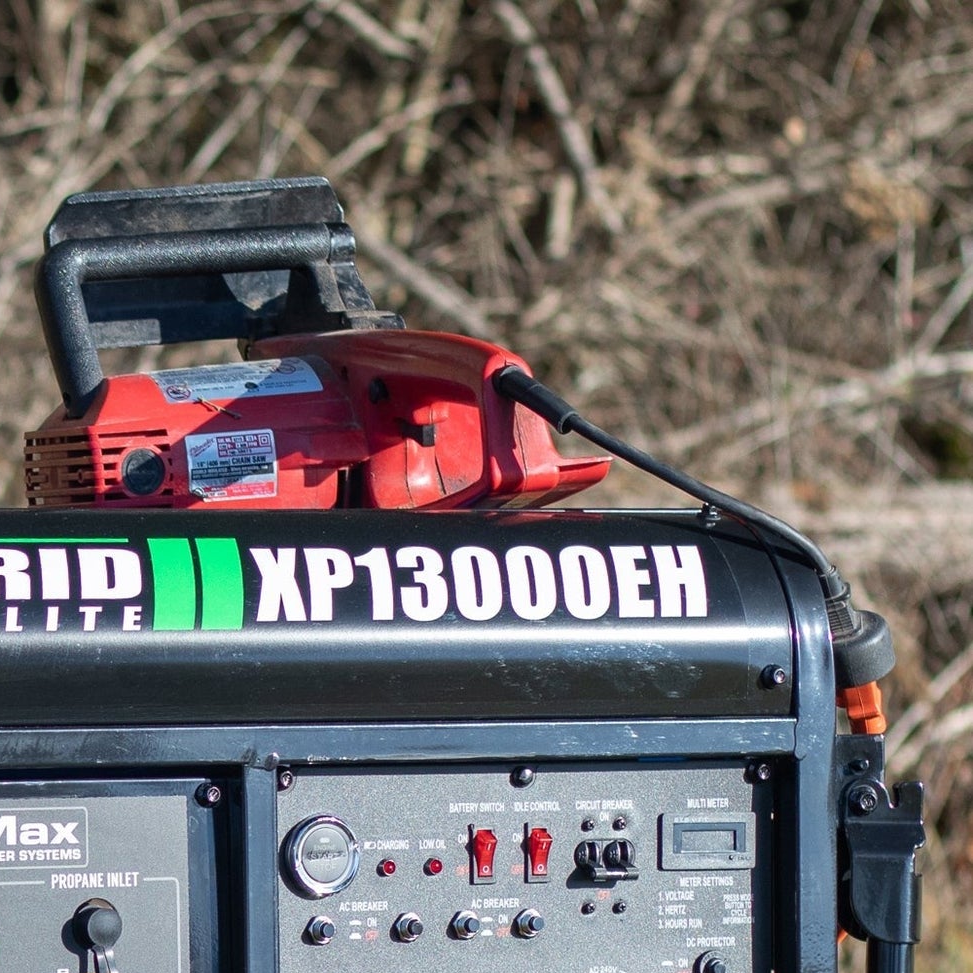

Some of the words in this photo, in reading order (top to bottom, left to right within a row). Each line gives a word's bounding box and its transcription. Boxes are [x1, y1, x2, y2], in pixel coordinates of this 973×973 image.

[231, 456, 251, 465] CHAIN
[252, 455, 266, 463] SAW
[248, 544, 709, 622] XP13000EH
[449, 803, 478, 813] BATTERY
[479, 802, 505, 812] SWITCH
[514, 802, 529, 811] IDLE
[529, 802, 561, 811] CONTROL
[576, 800, 600, 810] CIRCUIT
[601, 800, 634, 810] BREAKER
[687, 799, 706, 809] MULTI
[707, 798, 729, 808] METER
[599, 812, 609, 822] ON
[458, 834, 468, 844] ON
[512, 833, 523, 843] ON
[377, 840, 409, 850] CHARGING
[419, 840, 435, 849] LOW
[436, 839, 446, 849] OIL
[16, 848, 81, 862] SYSTEMS
[50, 873, 103, 889] PROPANE
[106, 871, 139, 888] INLET
[679, 878, 702, 888] METER
[703, 877, 734, 886] SETTINGS
[665, 891, 695, 901] VOLTAGE
[339, 903, 352, 912] AC
[354, 901, 388, 911] BREAKER
[471, 900, 483, 909] AC
[484, 898, 520, 908] BREAKER
[665, 905, 687, 915] HERTZ
[367, 917, 377, 926] ON
[498, 915, 509, 924] ON
[665, 919, 688, 929] HOURS
[689, 918, 703, 928] RUN
[687, 938, 696, 947] DC
[697, 937, 736, 947] PROTECTOR
[678, 959, 688, 968] ON
